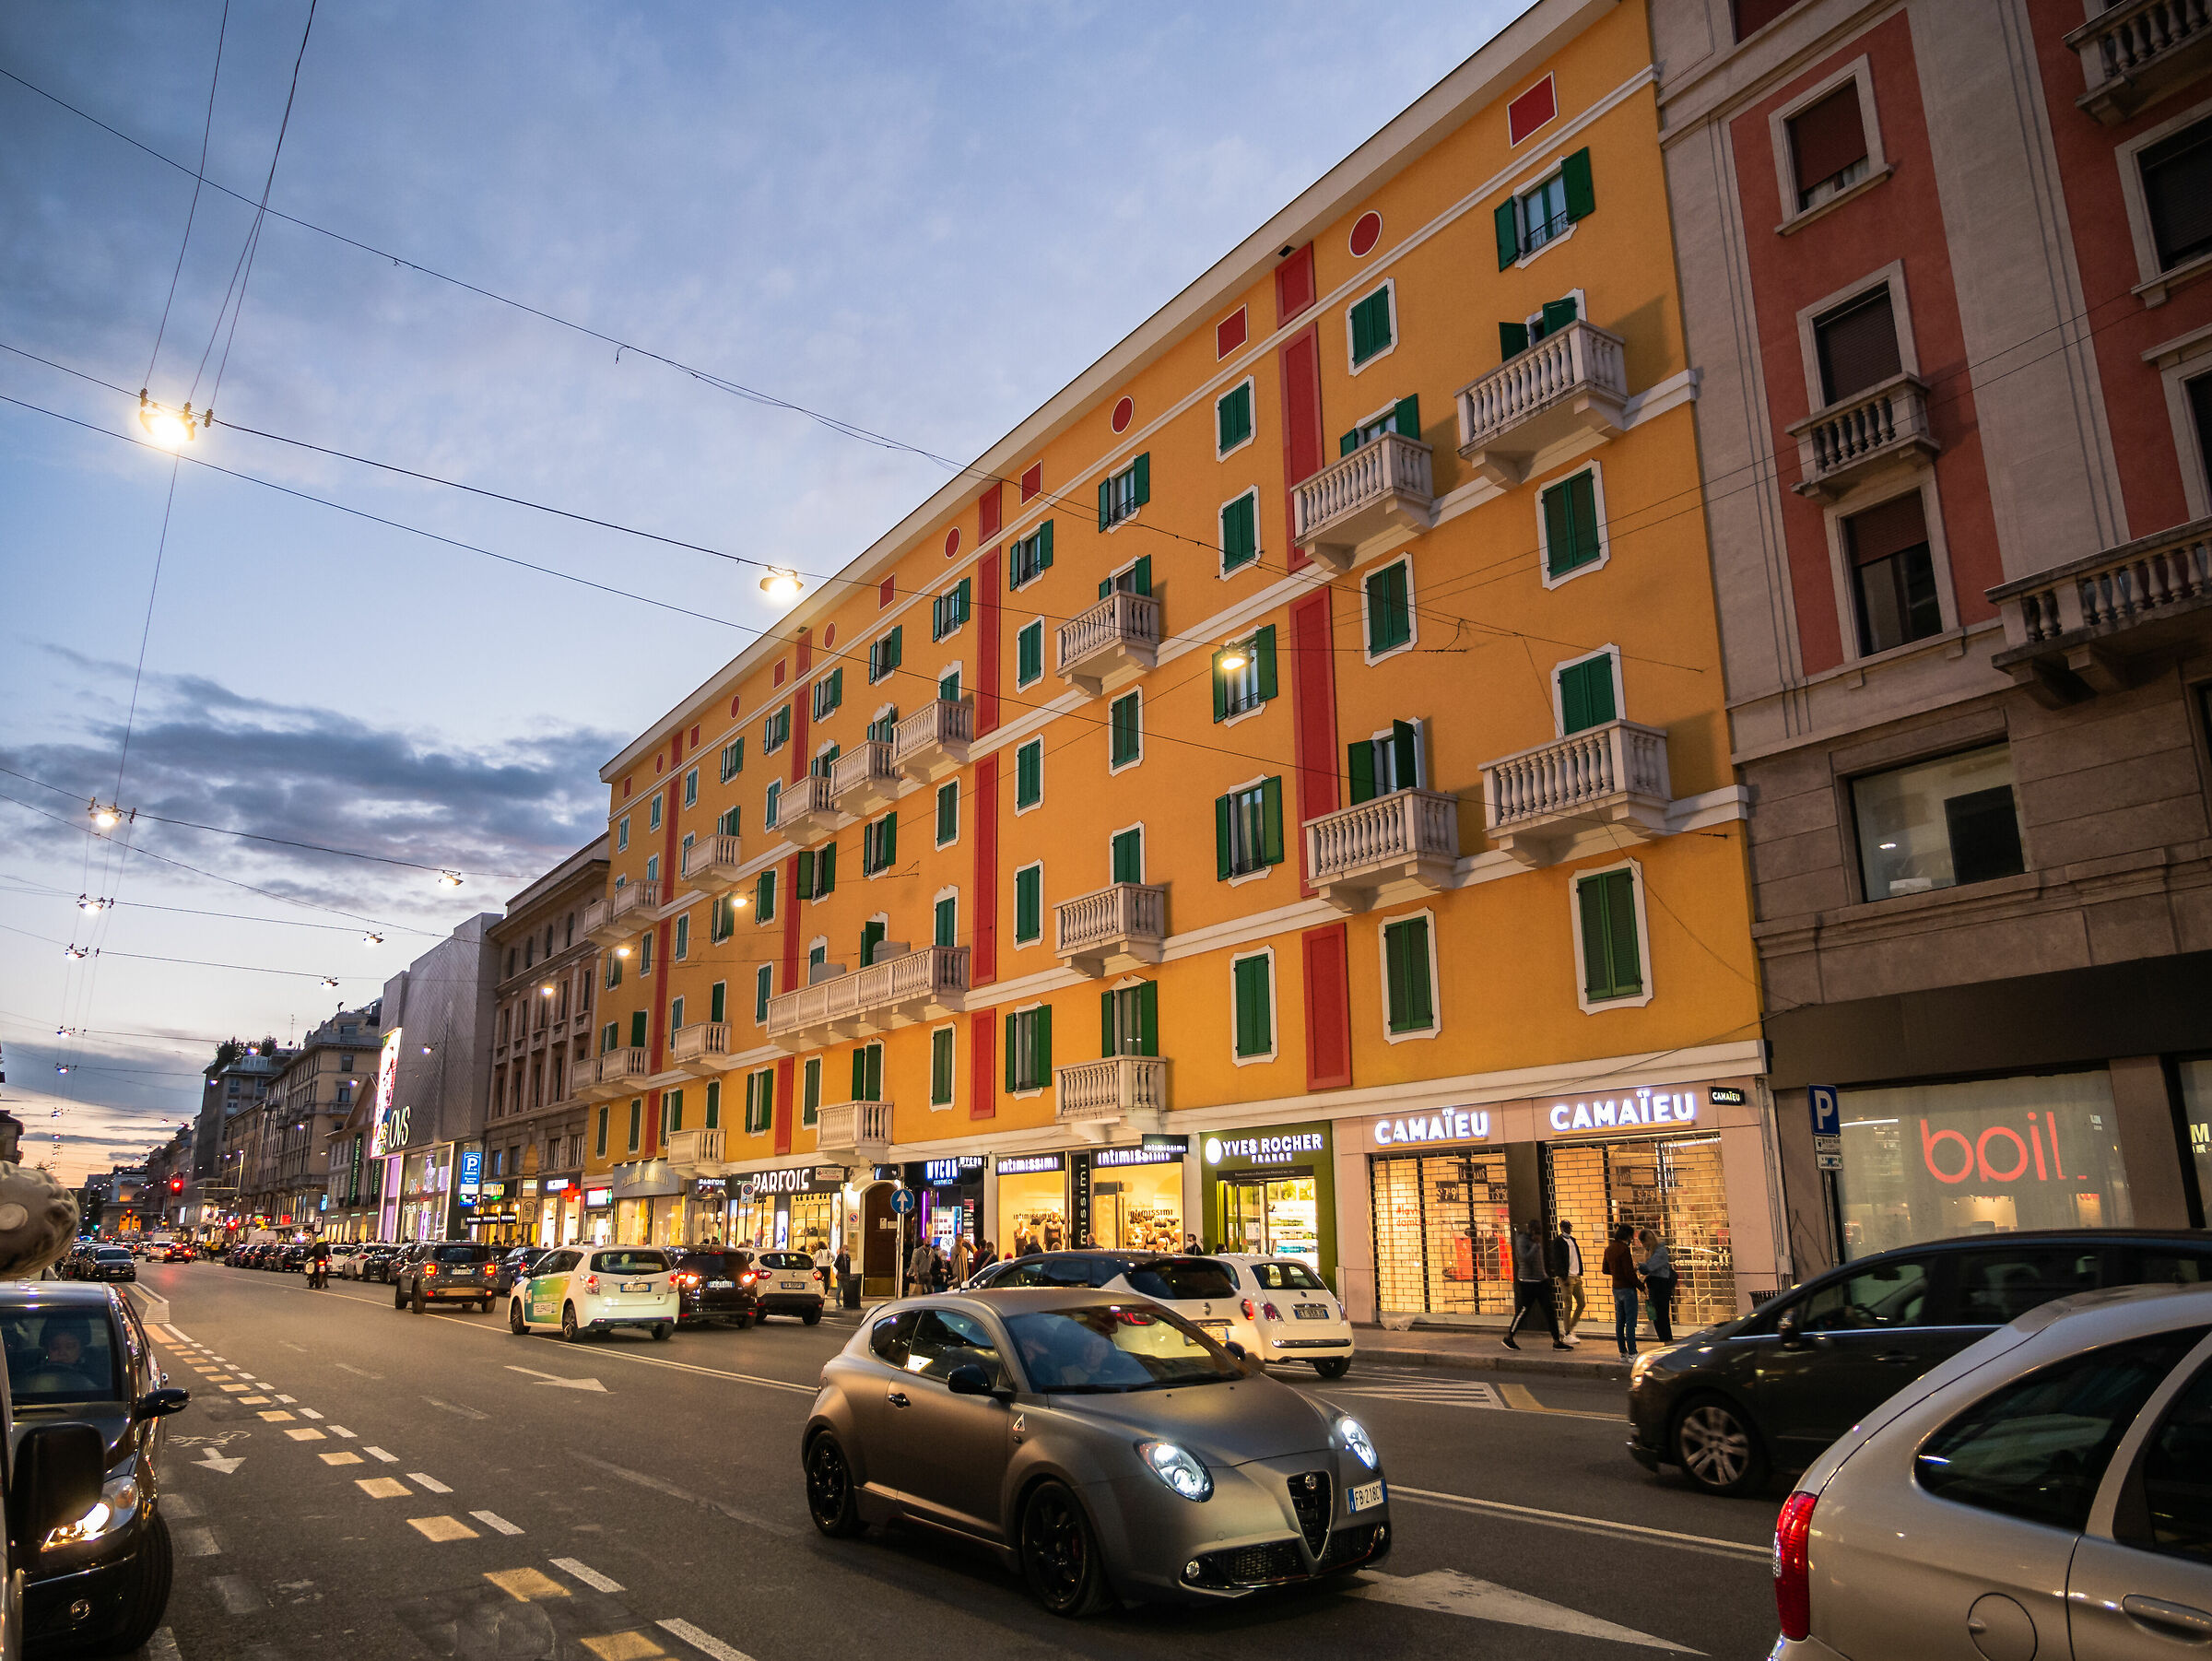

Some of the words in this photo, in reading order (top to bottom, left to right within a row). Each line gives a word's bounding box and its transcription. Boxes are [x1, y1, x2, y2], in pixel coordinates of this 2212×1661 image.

[1712, 1090, 1741, 1102] CAMAÏEU
[1549, 1090, 1695, 1131] CAMAÏEU
[1814, 1090, 1833, 1130] P
[389, 1105, 410, 1149] OVS
[1374, 1107, 1488, 1145] CAMAÏEU
[1144, 1144, 1186, 1152] intimissimi
[1222, 1138, 1258, 1157] YVES
[1261, 1133, 1323, 1154] ROCHER
[466, 1157, 477, 1172] P
[998, 1156, 1058, 1173] intimissimi
[1251, 1152, 1292, 1164] FRANCE
[926, 1159, 958, 1180] WYCON
